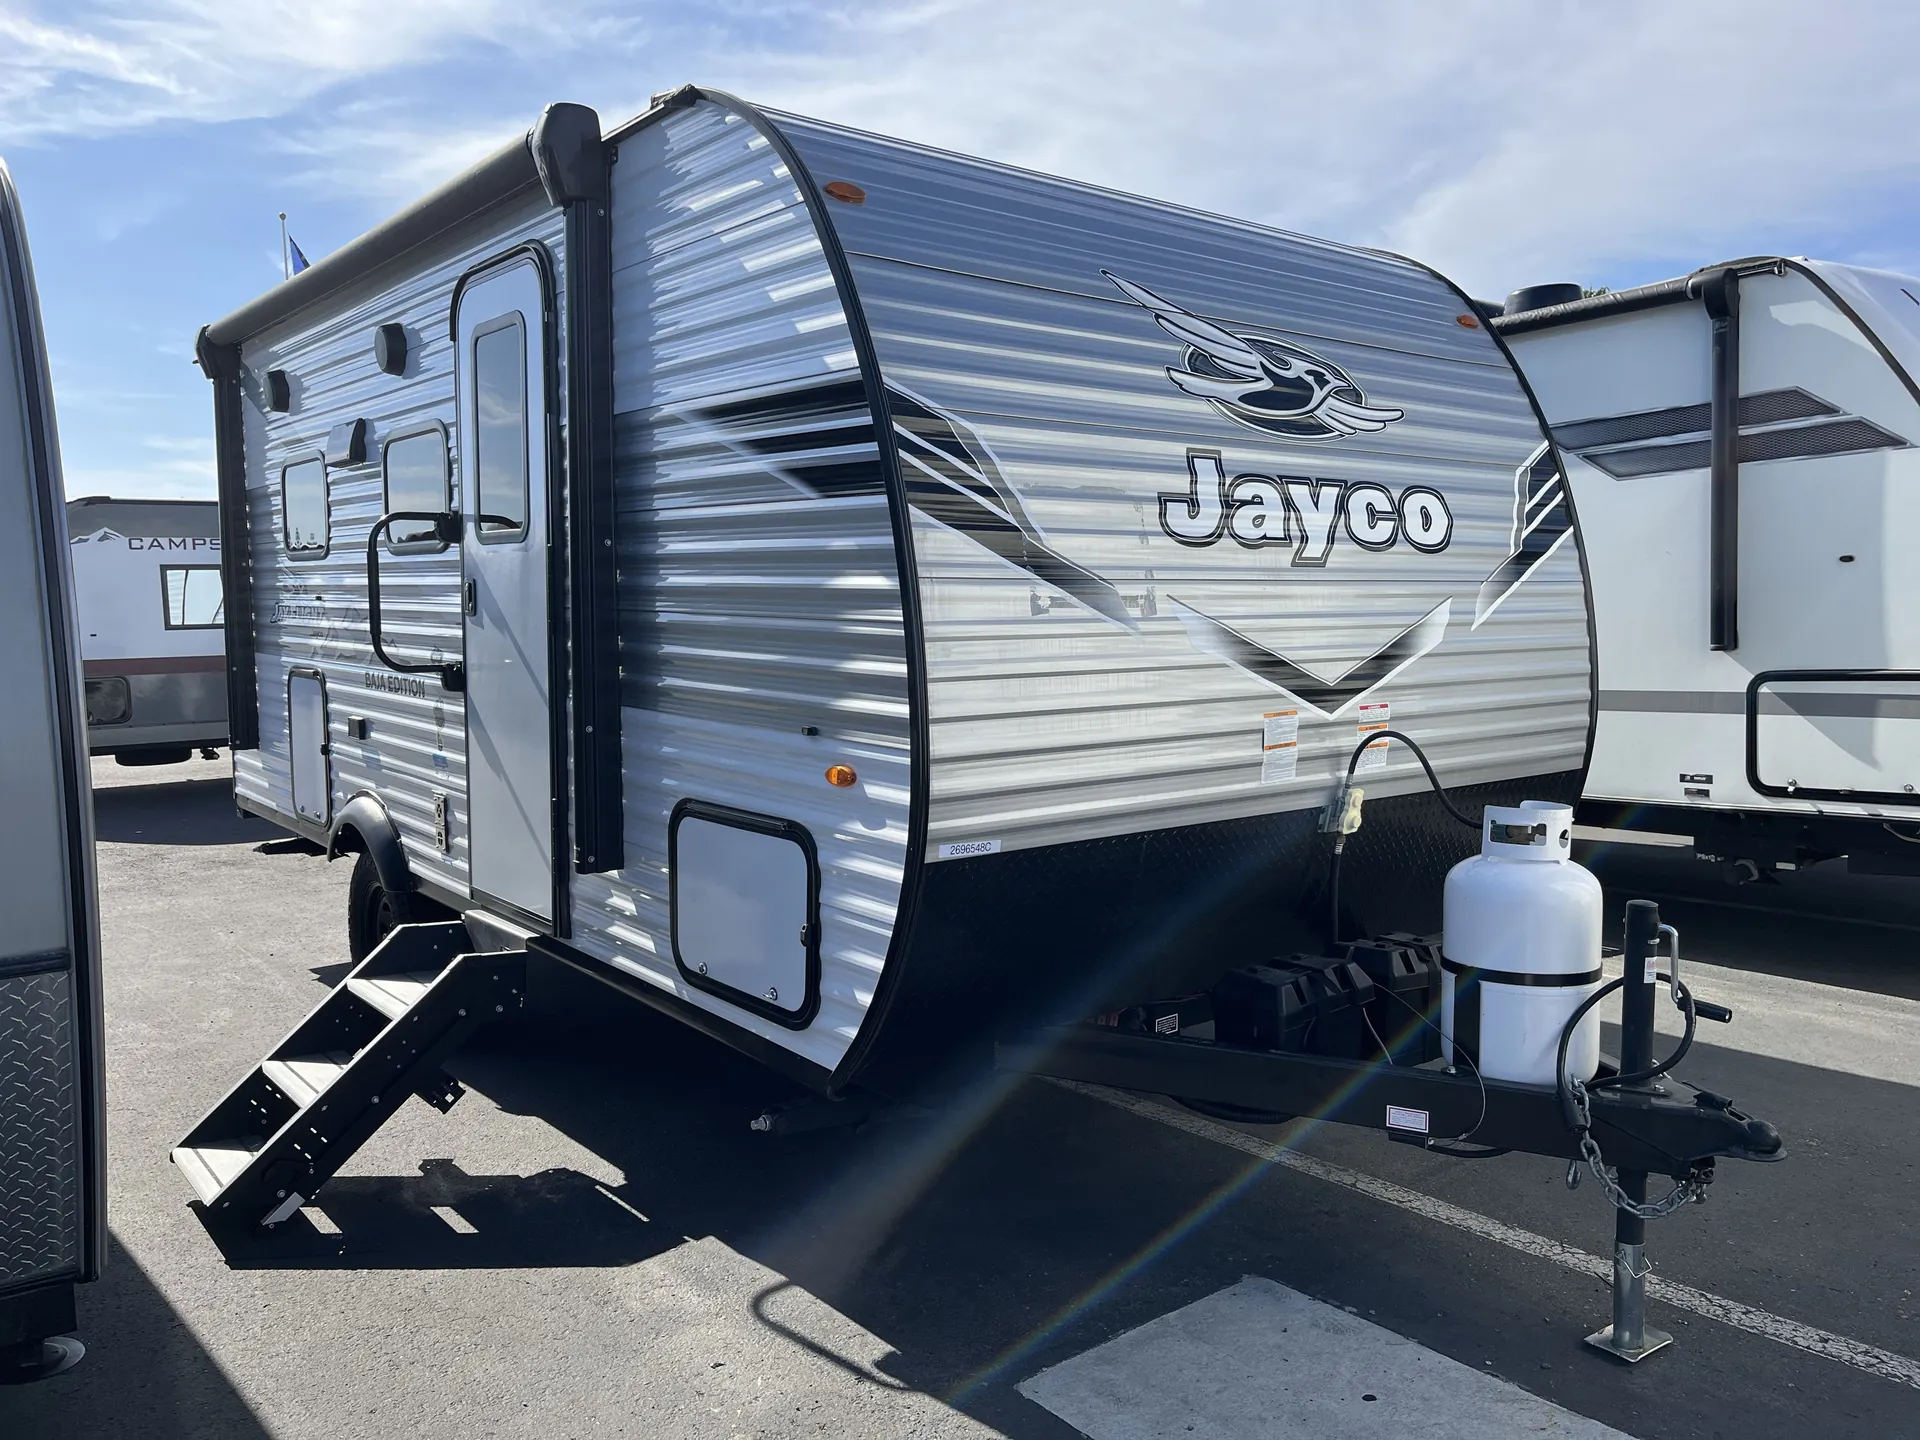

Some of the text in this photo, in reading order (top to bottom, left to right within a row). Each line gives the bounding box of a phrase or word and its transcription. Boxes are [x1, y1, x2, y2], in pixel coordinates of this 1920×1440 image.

[1157, 447, 1453, 568] Jayco
[128, 537, 221, 551] CAMPS
[364, 672, 426, 698] BAJA EDITION
[950, 841, 992, 855] 2696548C
